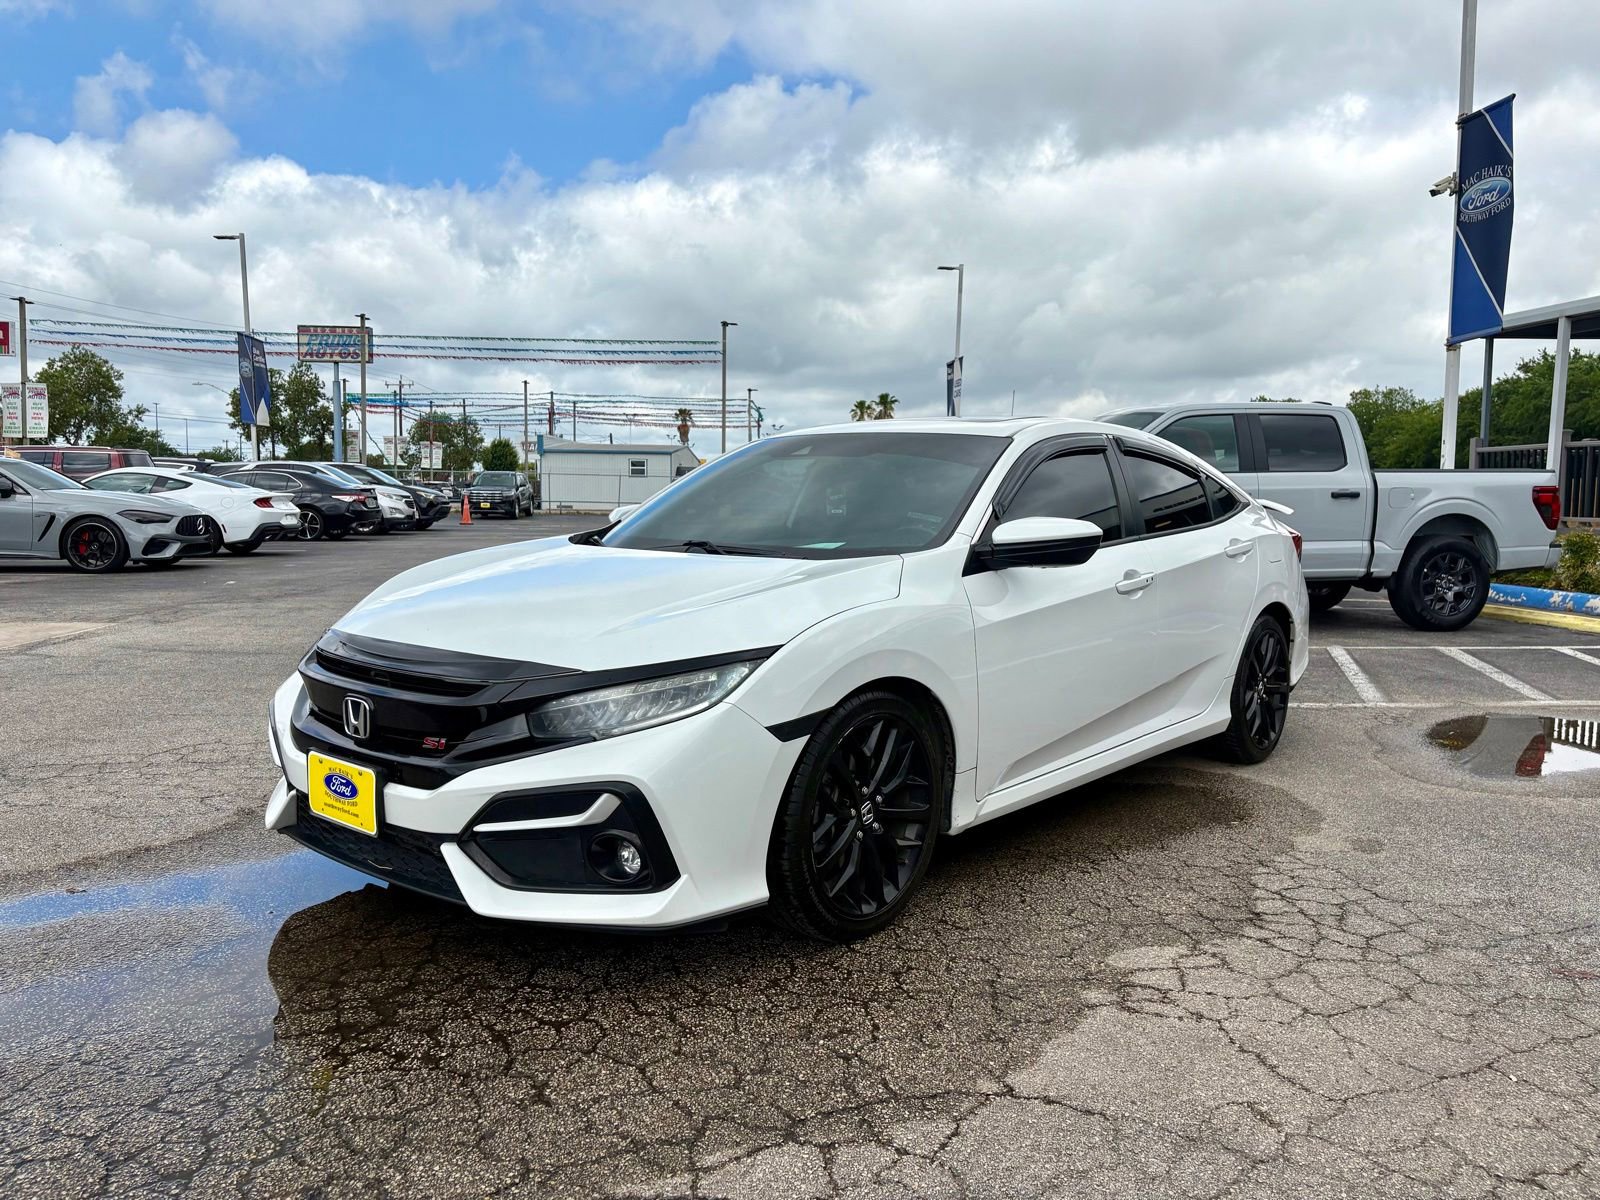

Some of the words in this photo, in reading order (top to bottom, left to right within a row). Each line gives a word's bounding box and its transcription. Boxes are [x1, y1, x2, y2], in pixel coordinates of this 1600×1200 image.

[1461, 171, 1480, 193] MAC
[1481, 164, 1512, 180] HAIK'S
[1468, 182, 1501, 210] Ford
[1459, 209, 1490, 223] SOUTHWAY
[1491, 197, 1511, 216] FORD
[303, 345, 361, 360] AUTOS
[330, 775, 352, 796] Ford
